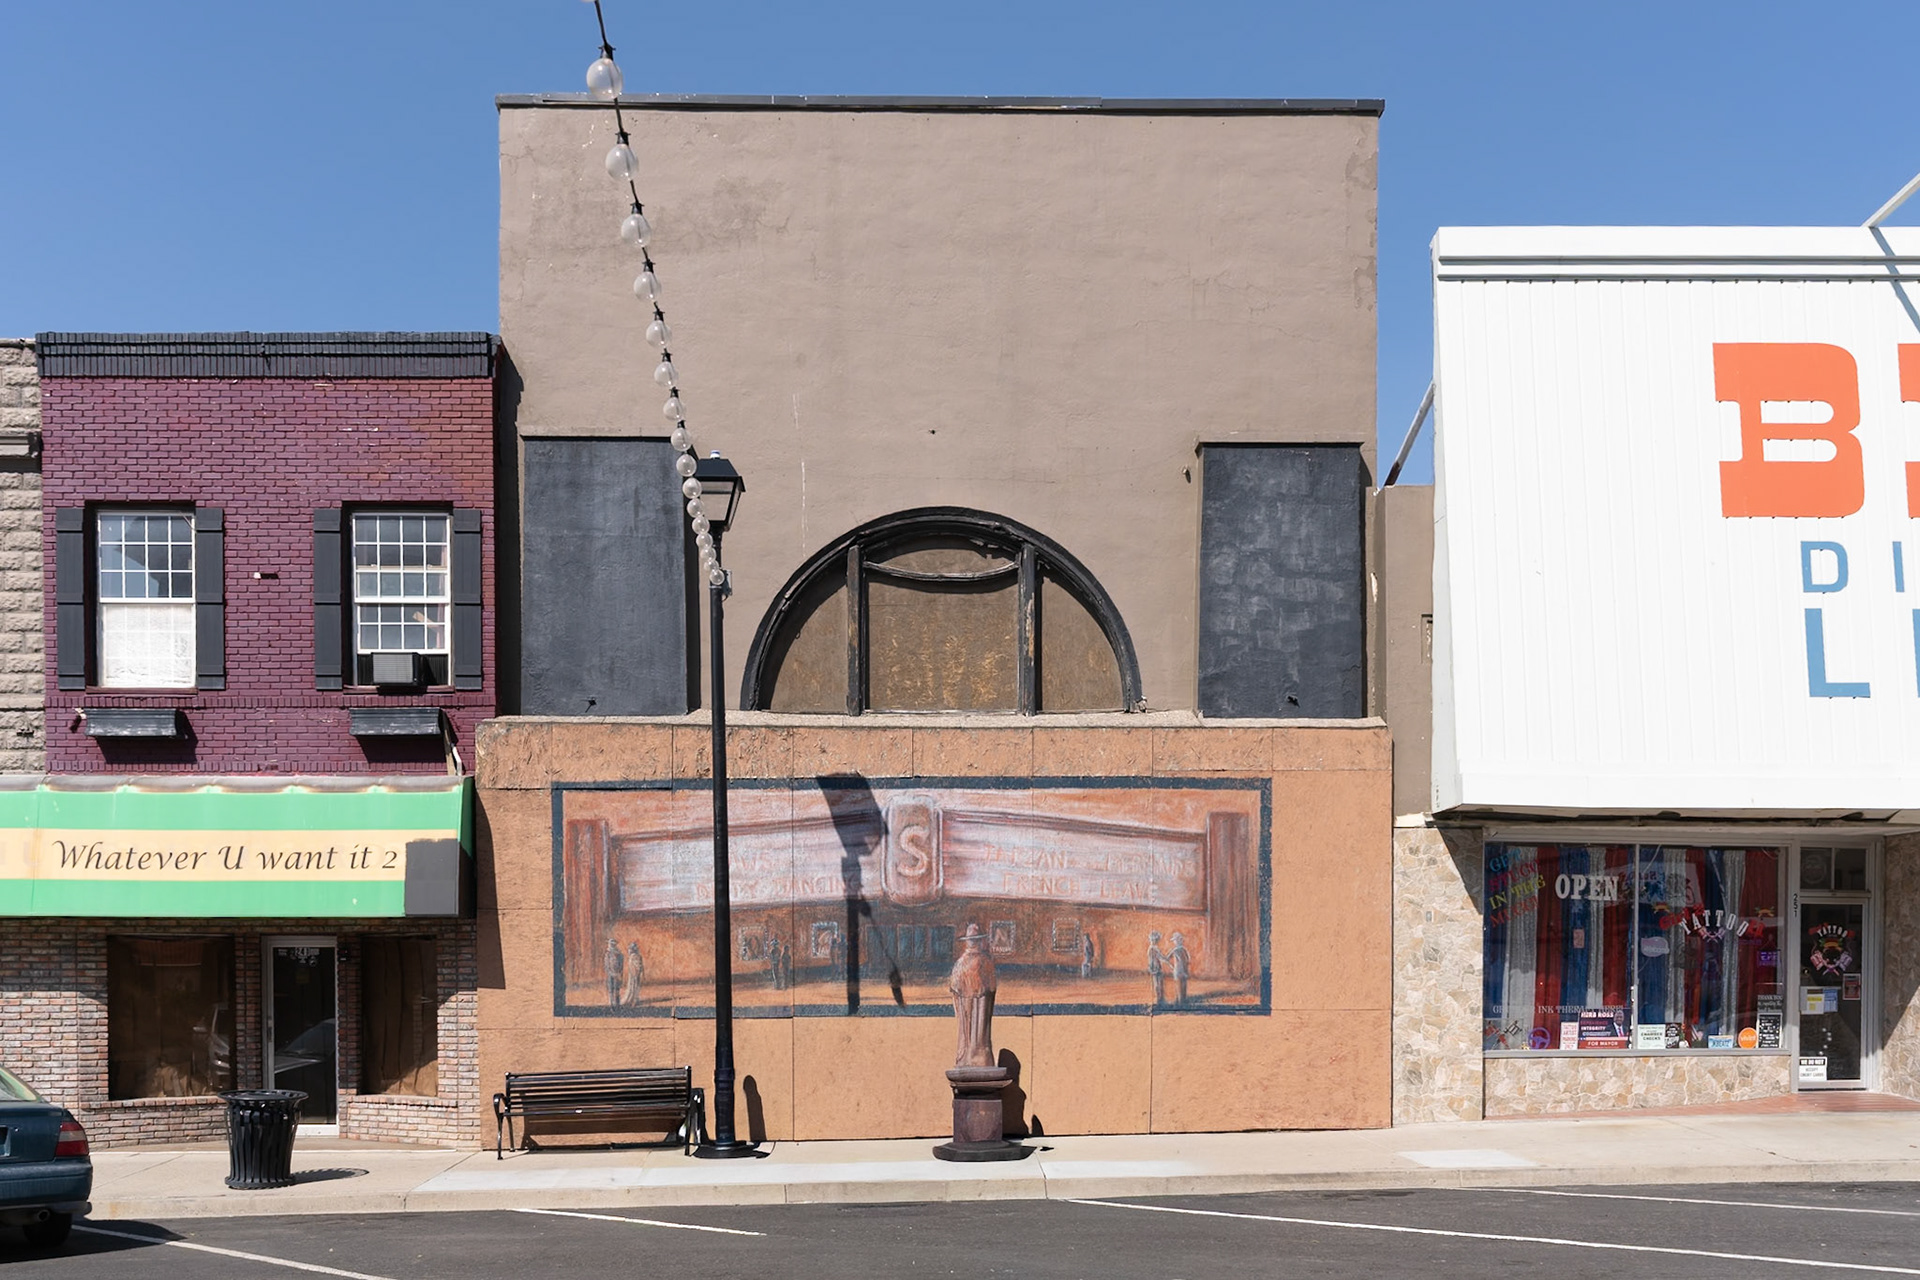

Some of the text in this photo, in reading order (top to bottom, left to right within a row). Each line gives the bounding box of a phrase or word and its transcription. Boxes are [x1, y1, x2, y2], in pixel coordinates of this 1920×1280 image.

[52, 840, 206, 871] Whatever
[218, 845, 246, 871] U
[257, 851, 338, 870] want
[349, 846, 372, 870] it
[381, 850, 399, 870] 2
[897, 824, 930, 877] S
[1489, 847, 1522, 872] GET
[1003, 872, 1081, 896] FRENCH
[1100, 879, 1159, 903] LEAVE
[1489, 874, 1546, 910] IN THE
[1555, 873, 1620, 901] OPEN
[1679, 909, 1750, 937] TATTOO
[1817, 924, 1849, 939] TATTOO
[1538, 1006, 1555, 1014] INK
